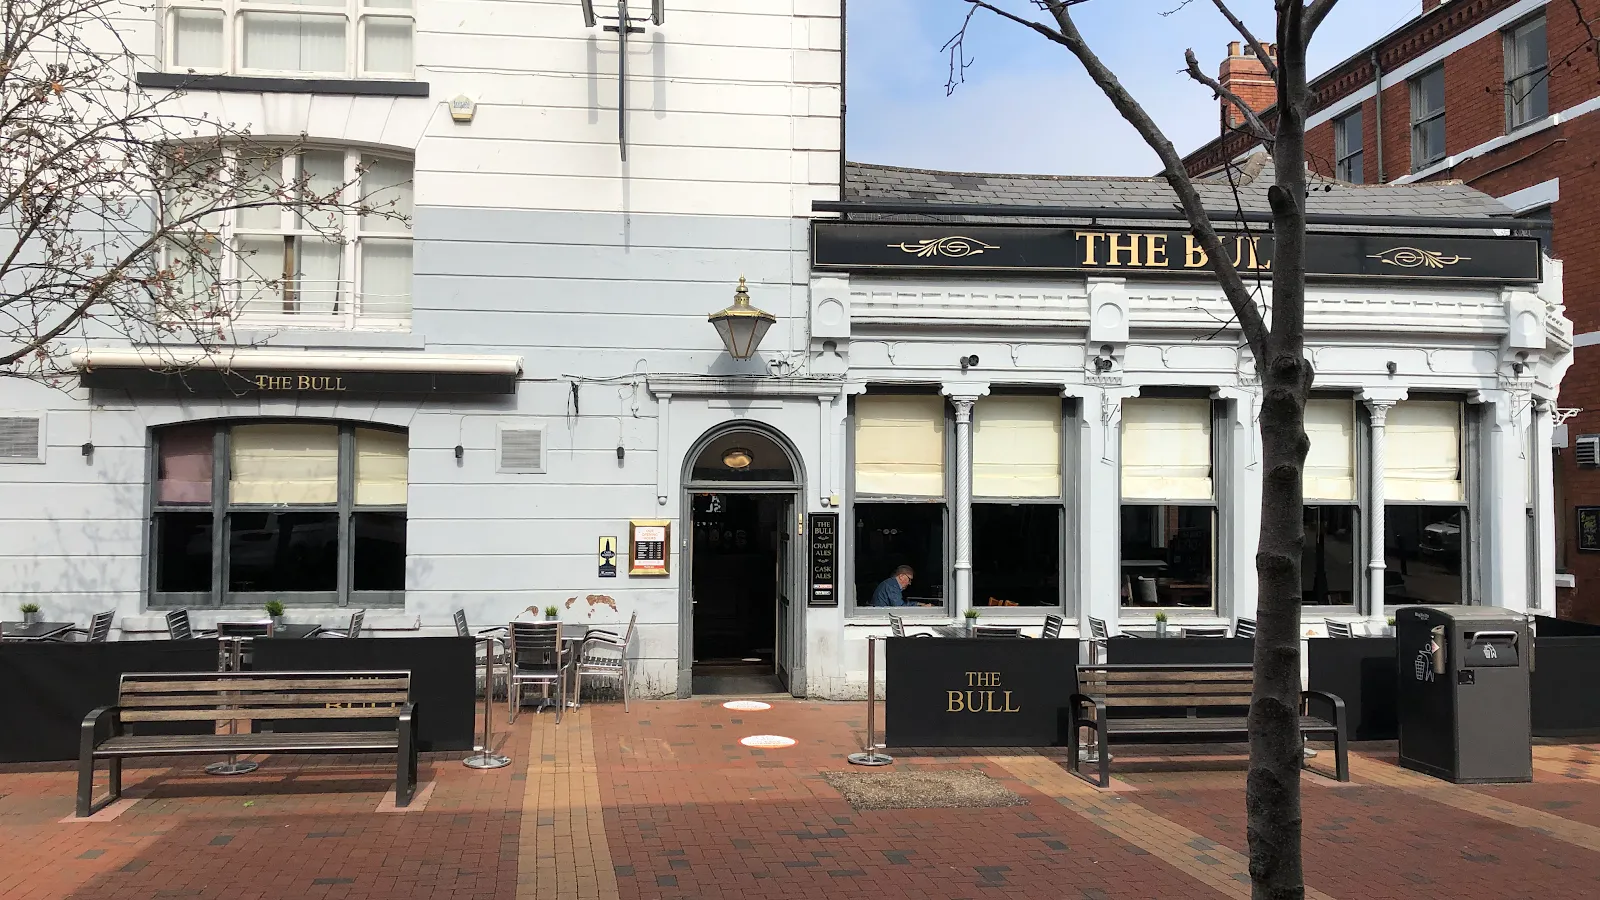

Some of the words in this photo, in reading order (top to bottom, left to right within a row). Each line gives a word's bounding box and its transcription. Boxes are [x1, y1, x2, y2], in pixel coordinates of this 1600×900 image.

[1075, 231, 1169, 267] THE
[1182, 234, 1275, 269] BUL
[255, 374, 293, 390] THE
[297, 375, 347, 391] BULL
[814, 527, 834, 535] BULL
[965, 671, 1002, 687] THE
[946, 690, 1021, 713] BULL
